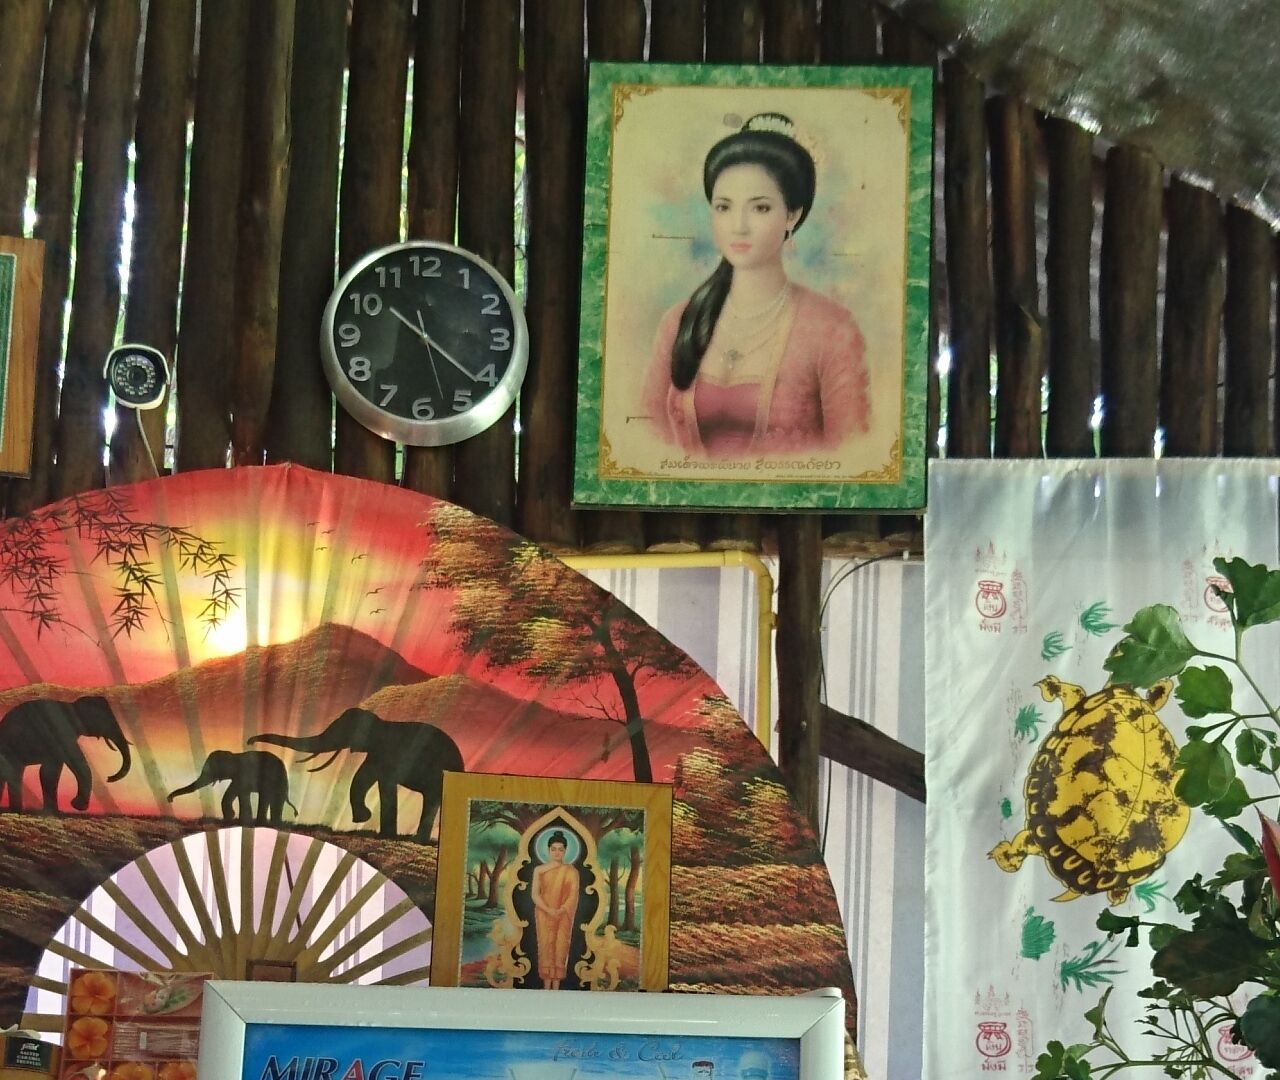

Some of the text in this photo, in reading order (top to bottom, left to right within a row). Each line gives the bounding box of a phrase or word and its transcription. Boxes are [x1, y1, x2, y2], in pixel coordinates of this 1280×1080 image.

[375, 267, 401, 288] 11
[409, 256, 441, 277] 12
[458, 268, 470, 289] 1
[350, 294, 382, 316] 10
[481, 294, 501, 316] 2
[338, 323, 361, 347] 9
[489, 328, 510, 350] 3
[348, 356, 371, 381] 8
[476, 363, 498, 387] 4
[379, 384, 398, 406] 7
[452, 390, 472, 412] 5
[412, 398, 435, 420] 6
